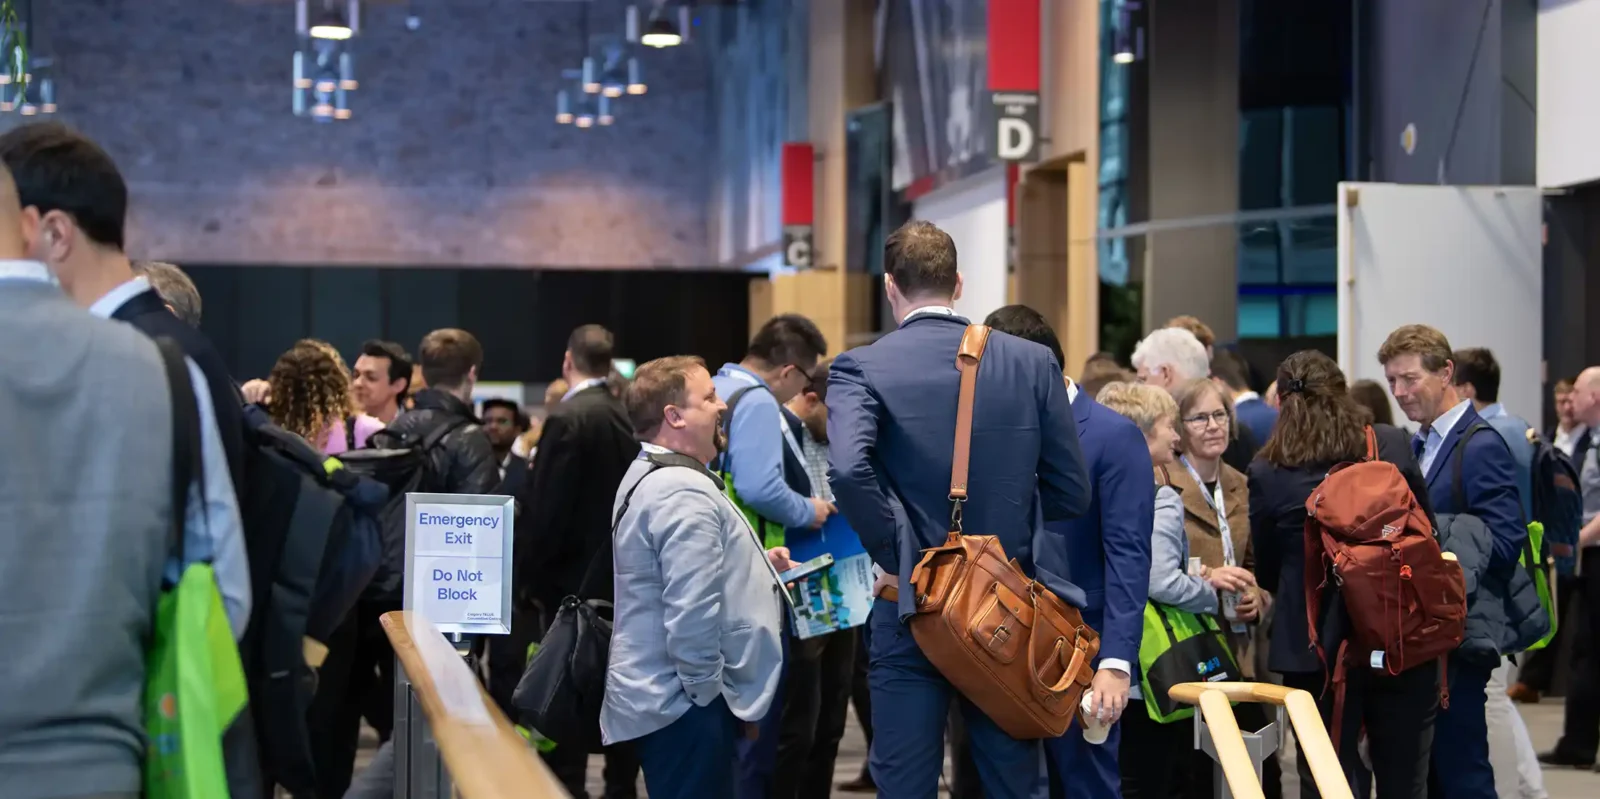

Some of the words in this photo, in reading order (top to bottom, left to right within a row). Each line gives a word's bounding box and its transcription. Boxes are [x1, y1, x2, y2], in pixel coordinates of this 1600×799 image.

[998, 118, 1033, 159] D
[788, 241, 810, 266] C
[419, 512, 499, 529] Emergency
[445, 532, 473, 544] Exit
[433, 569, 453, 581] Do
[457, 569, 483, 582] Not
[437, 588, 477, 600] Block
